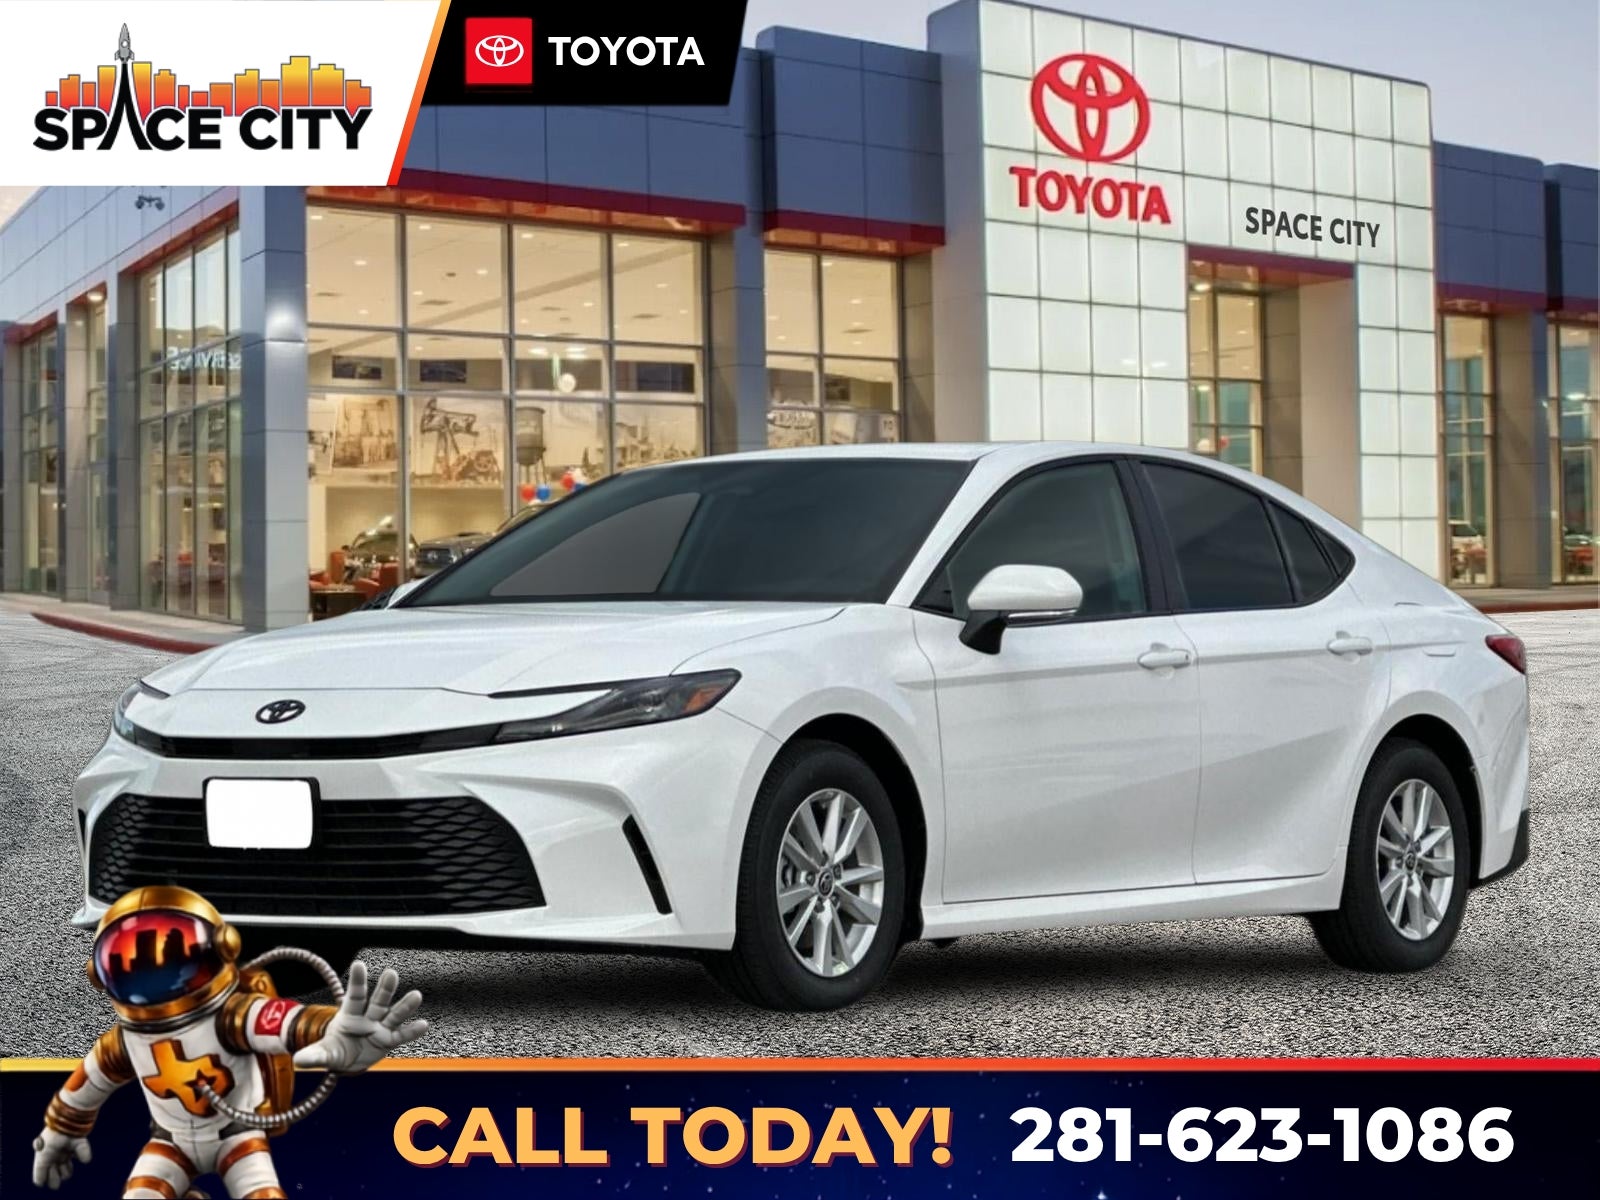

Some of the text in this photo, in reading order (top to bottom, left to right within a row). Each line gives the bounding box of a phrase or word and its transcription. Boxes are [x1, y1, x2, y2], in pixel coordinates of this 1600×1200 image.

[1009, 165, 1171, 224] TOYOTA
[1245, 206, 1380, 248] SPACE CITY
